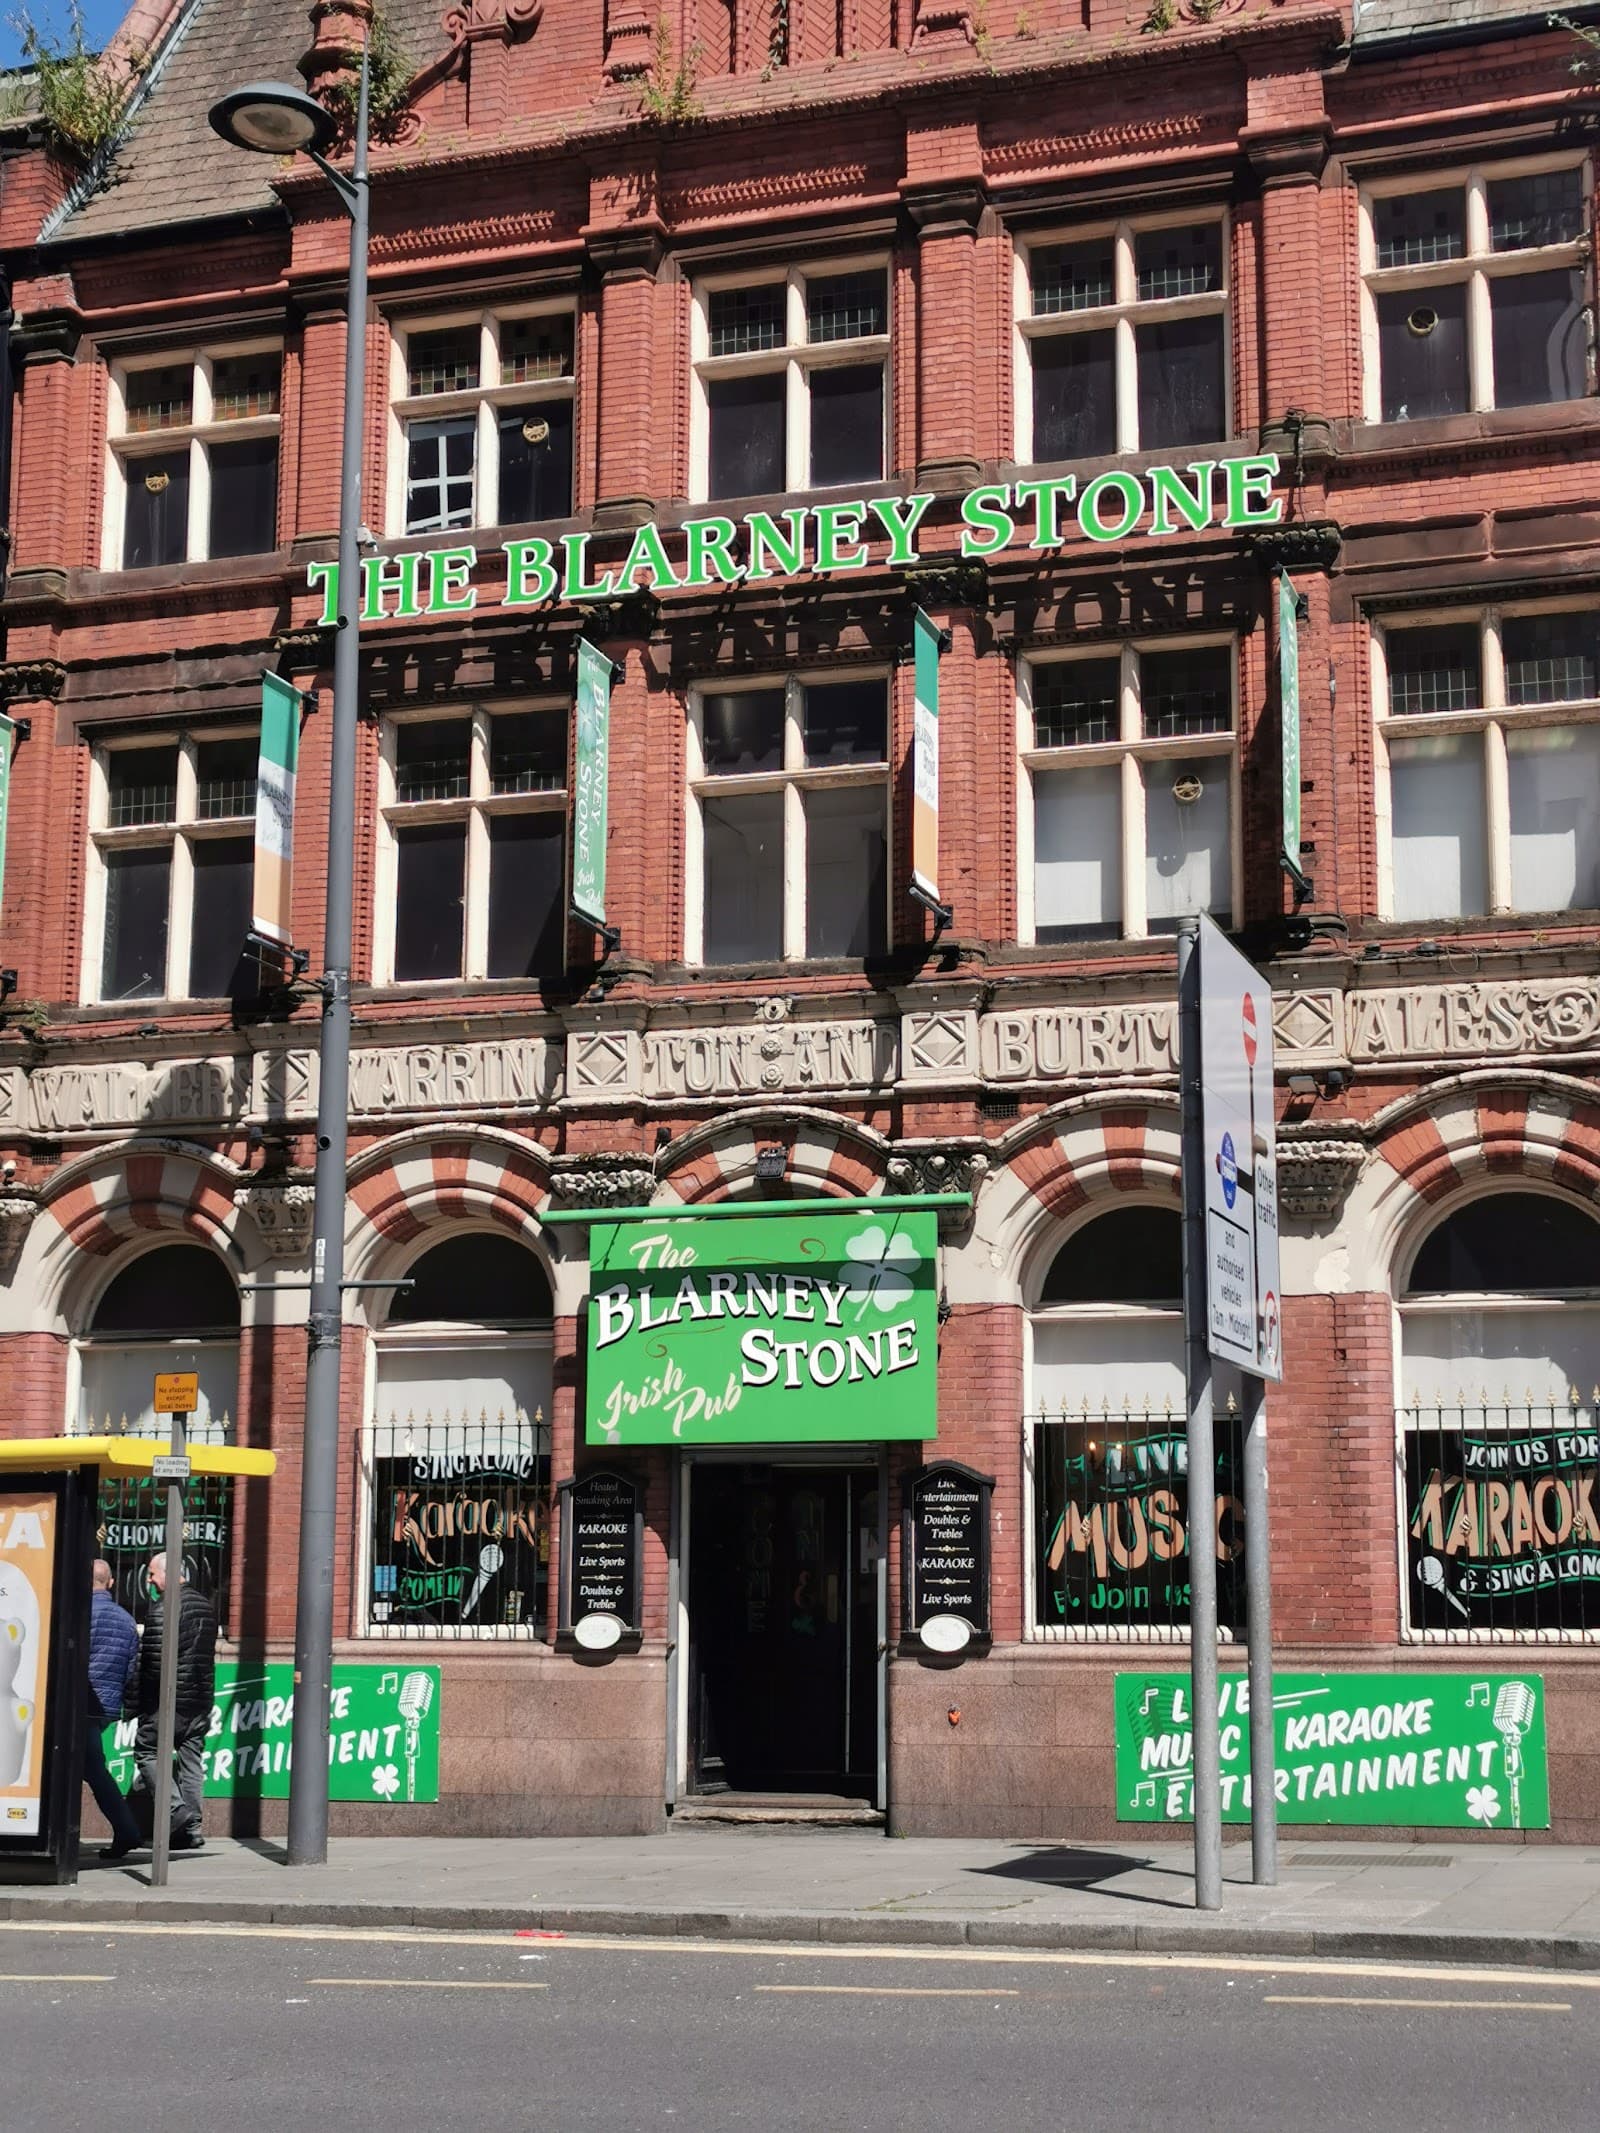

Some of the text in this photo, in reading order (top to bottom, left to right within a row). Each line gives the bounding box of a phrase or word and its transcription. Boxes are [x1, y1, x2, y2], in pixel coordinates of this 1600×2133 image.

[307, 453, 1284, 627] THE BLARNEY STONE
[579, 761, 593, 863] STONE
[995, 1009, 1181, 1078] BURT
[1355, 989, 1524, 1059] ALES
[1257, 1165, 1274, 1195] Other
[1258, 1201, 1276, 1229] traffic
[1225, 1230, 1236, 1249] and
[629, 1234, 699, 1274] The
[1216, 1254, 1245, 1281] authorised
[1220, 1283, 1242, 1308] vehicles
[594, 1272, 852, 1352] BLARNEY
[1228, 1309, 1251, 1341] Midnight
[740, 1319, 920, 1389] STONE
[597, 1358, 687, 1431] Irish
[664, 1373, 743, 1437] Pub
[166, 1458, 188, 1467] loading
[1464, 1445, 1509, 1468] JOIN
[1515, 1440, 1549, 1466] US
[612, 1495, 632, 1505] Area
[578, 1523, 628, 1534] KARAOKE
[923, 1514, 971, 1525] Doubles &
[931, 1529, 963, 1539] Trebles
[1044, 1490, 1246, 1579] MUSC
[579, 1556, 625, 1569] Live Sports
[922, 1558, 975, 1569] KARAOKE
[580, 1585, 624, 1596] Doubles &
[587, 1599, 617, 1609] Trebles
[922, 1593, 972, 1607] Live Sports
[230, 1686, 353, 1734] KARAE
[1172, 1680, 1250, 1723] LVE
[1141, 1698, 1433, 1771] MUC KARAOKE
